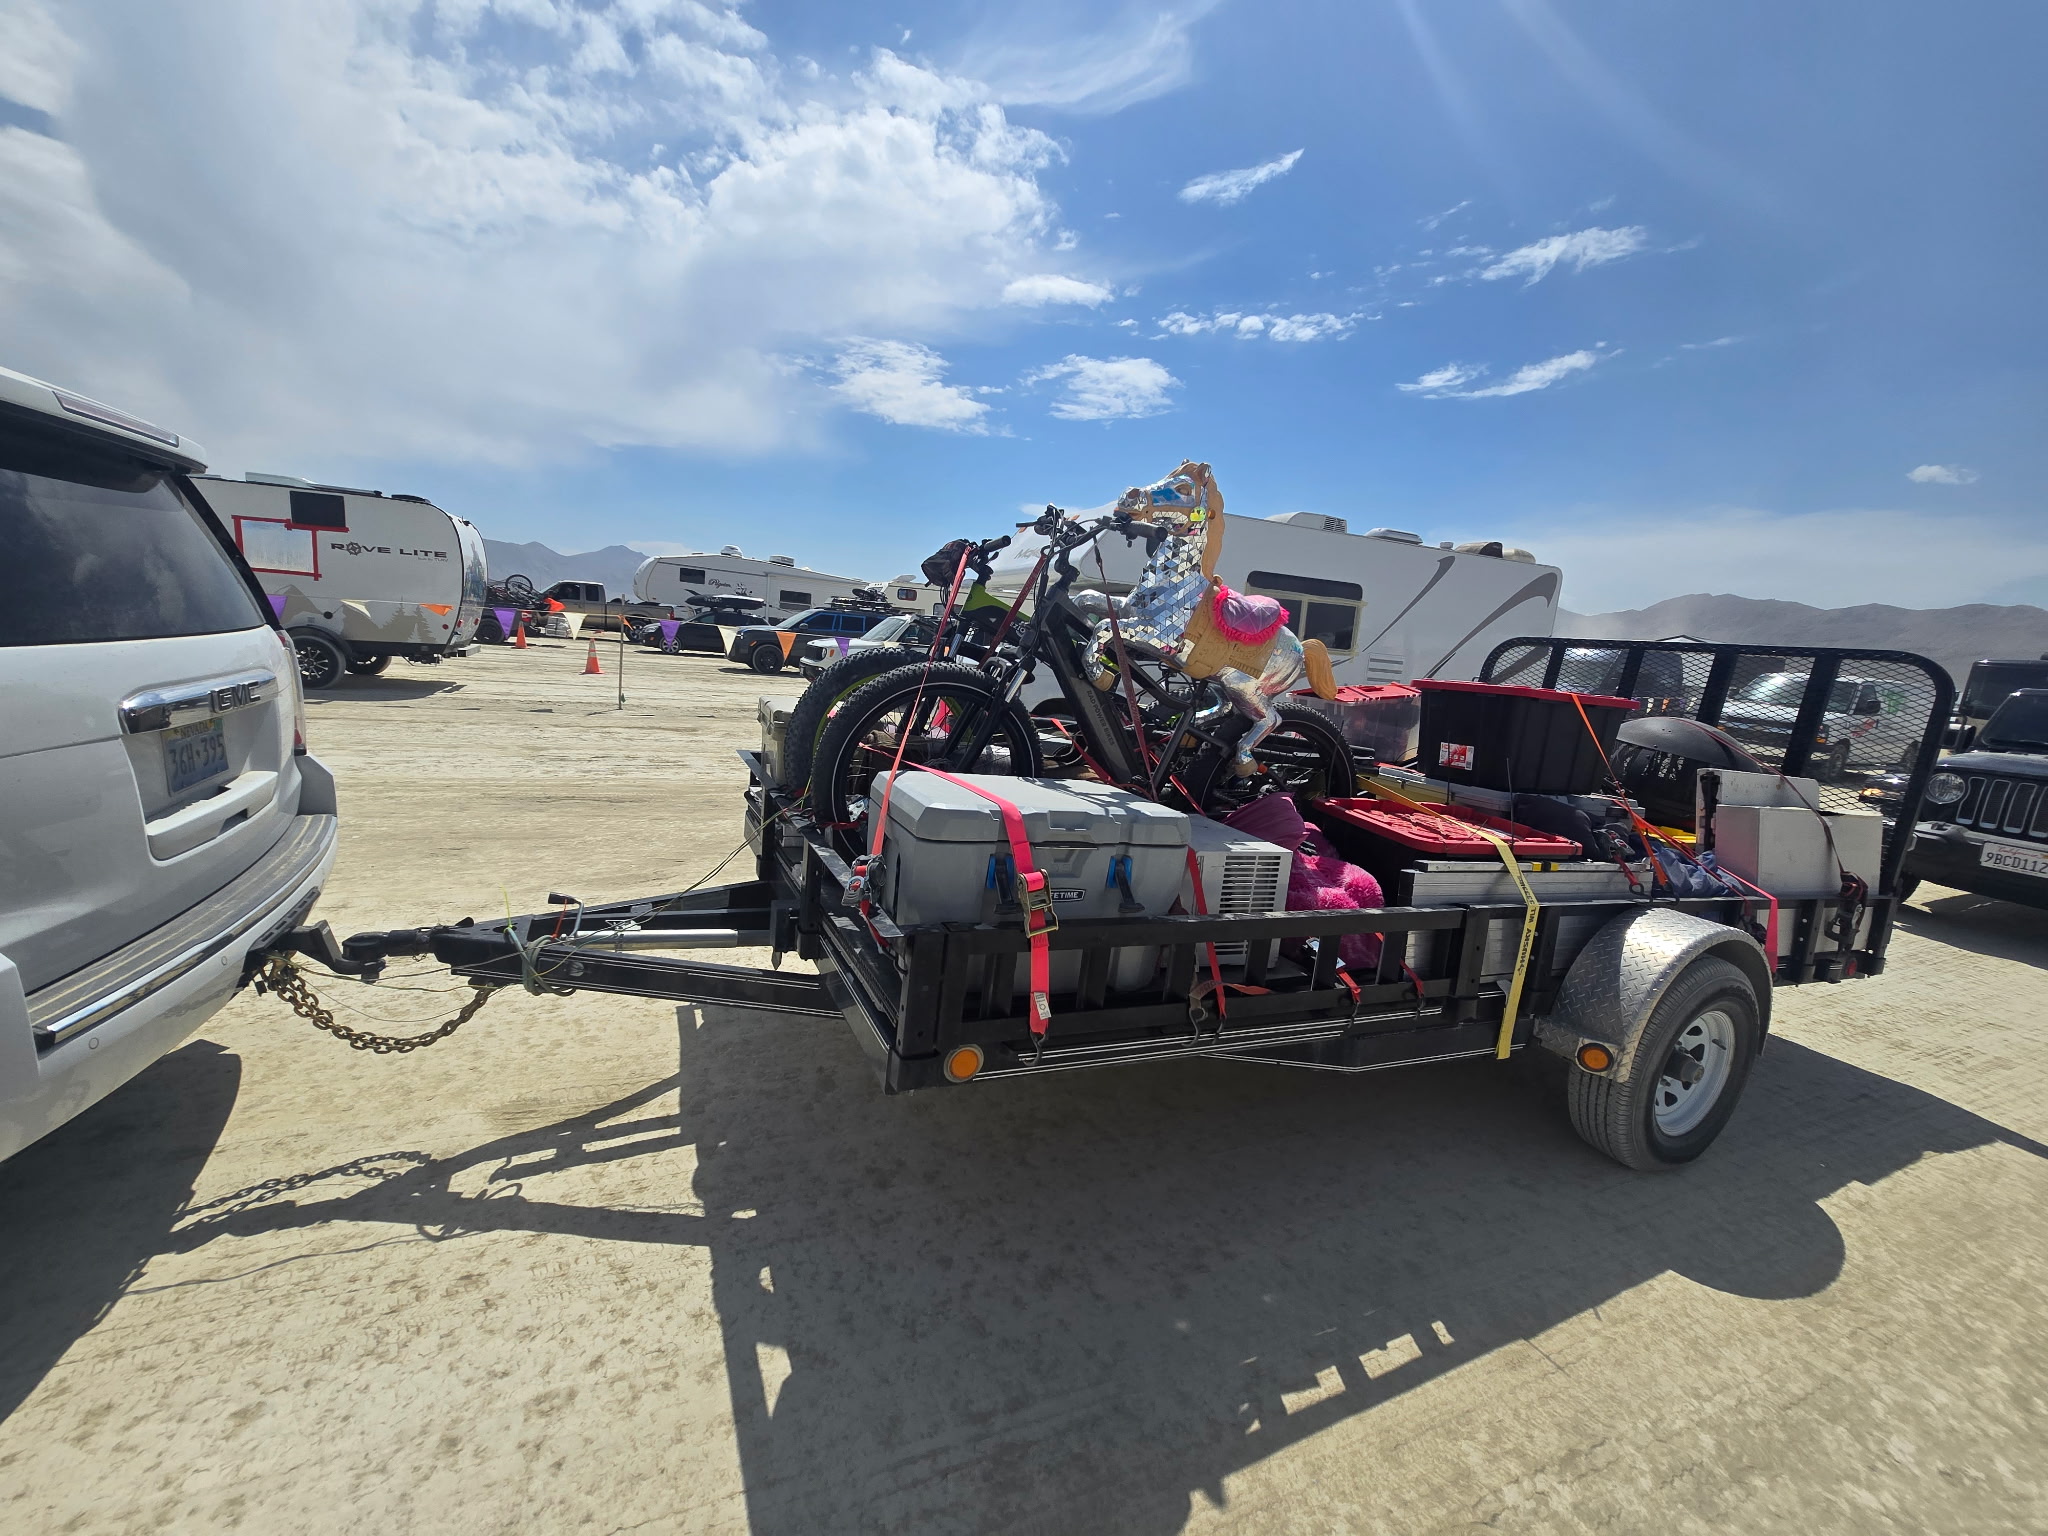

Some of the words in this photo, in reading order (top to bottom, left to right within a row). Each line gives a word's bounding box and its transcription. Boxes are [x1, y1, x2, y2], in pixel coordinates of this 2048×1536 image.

[399, 548, 447, 558] LITE
[217, 681, 261, 711] GMC
[1086, 689, 1096, 704] RAD
[1094, 704, 1107, 727] POWER
[1103, 727, 1116, 746] BIKES
[180, 720, 209, 738] NEVADA
[1983, 852, 2048, 874] 9BCD112
[1050, 891, 1079, 899] FETIME
